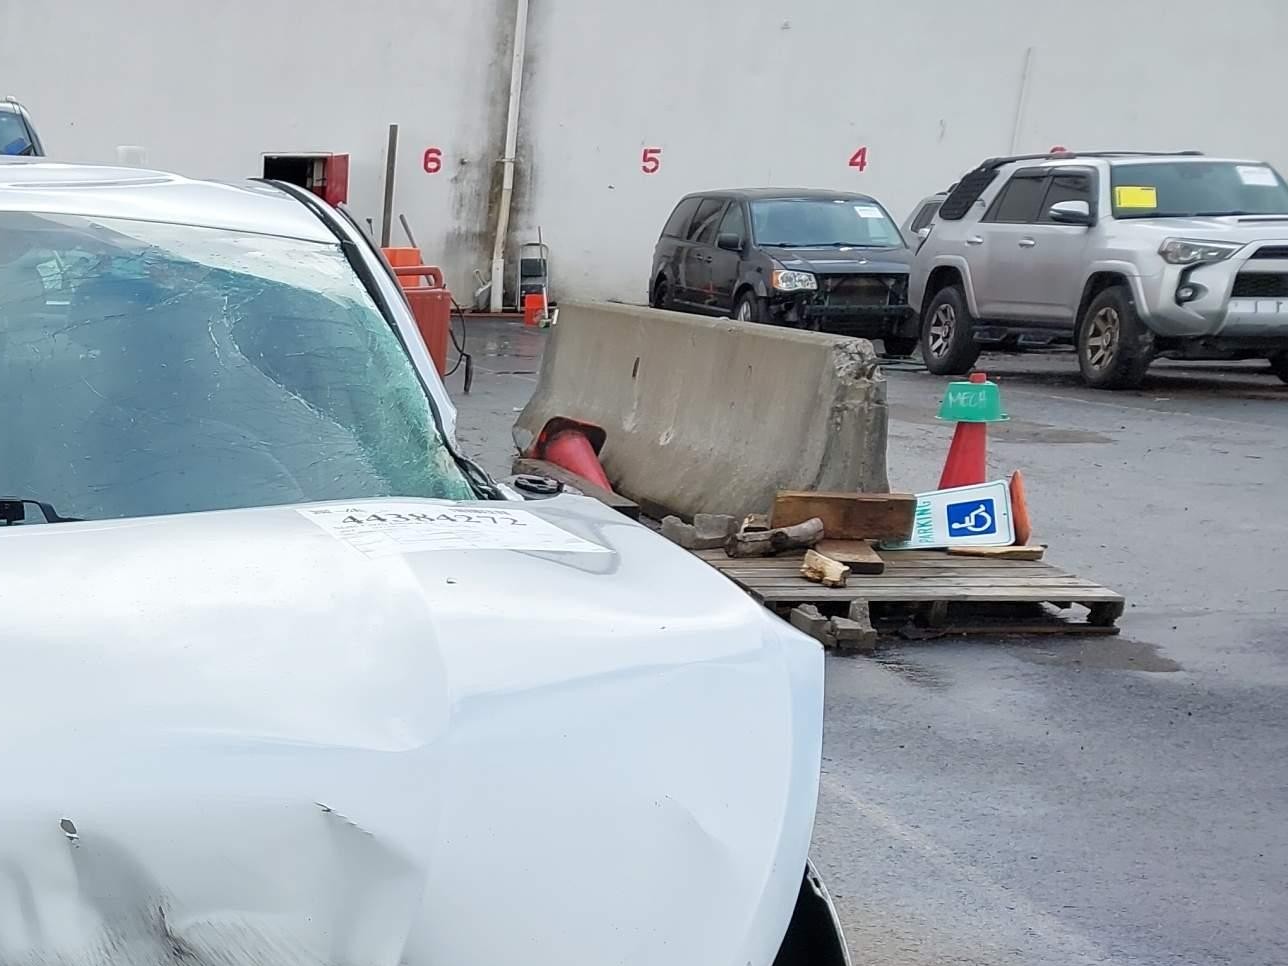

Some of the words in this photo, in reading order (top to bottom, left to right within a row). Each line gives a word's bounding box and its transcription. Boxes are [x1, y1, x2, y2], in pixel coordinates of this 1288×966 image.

[423, 148, 442, 174] 6
[641, 148, 662, 174] 5
[848, 147, 867, 172] 4
[948, 390, 987, 409] MECH
[341, 512, 527, 527] 44384272
[916, 501, 935, 543] PARKING
